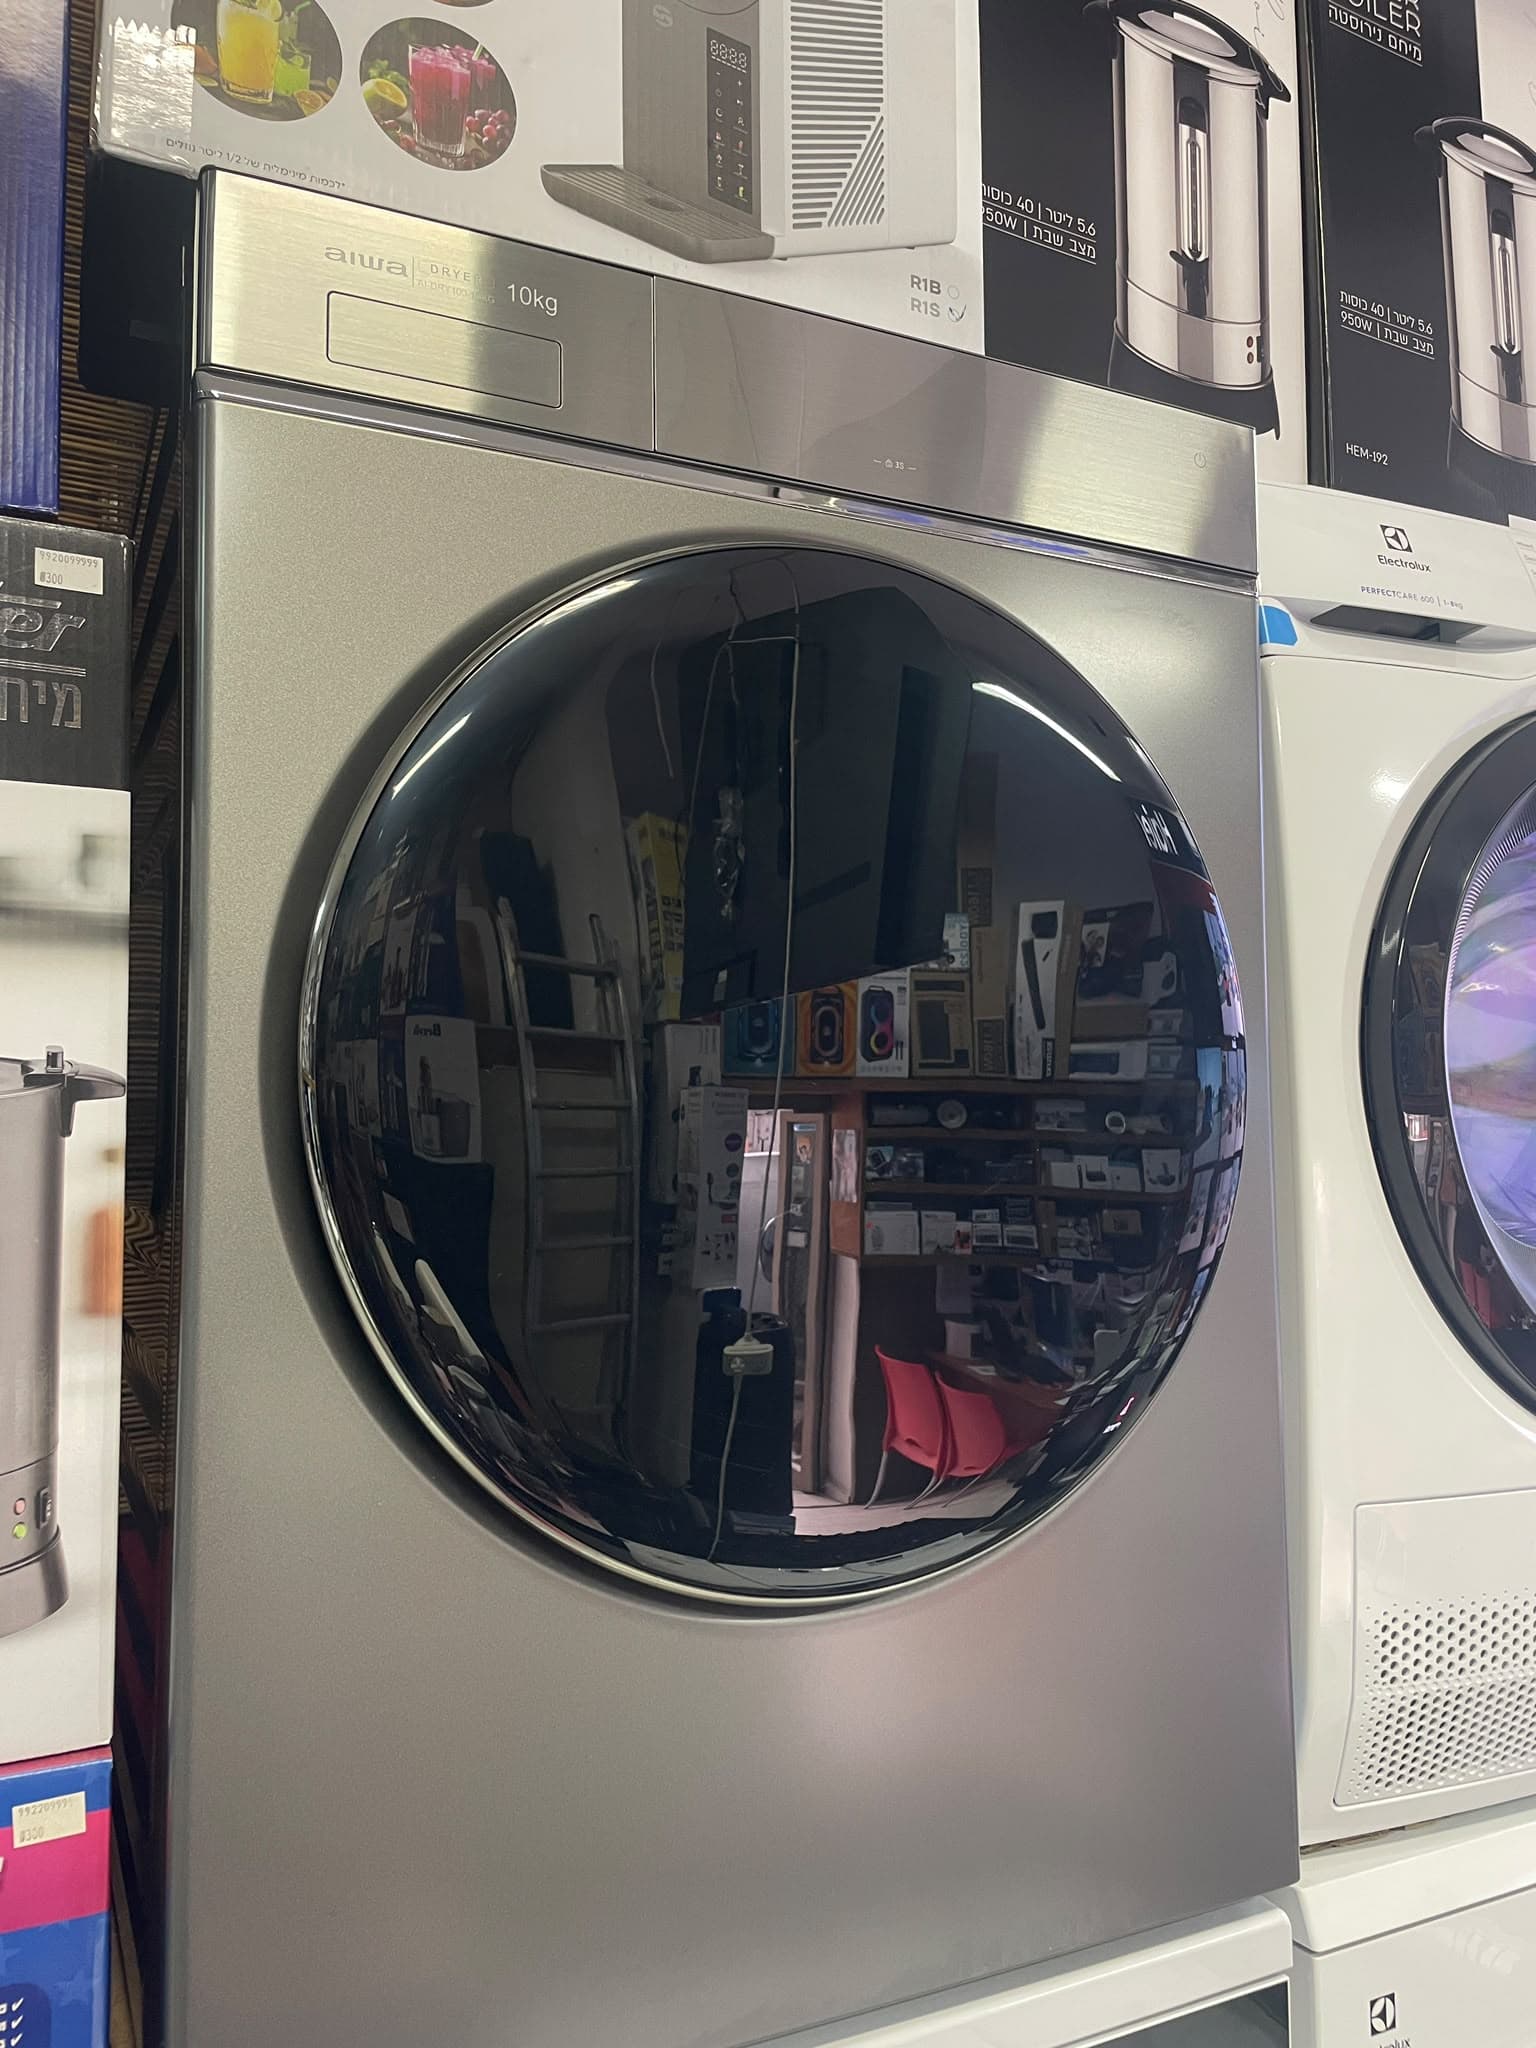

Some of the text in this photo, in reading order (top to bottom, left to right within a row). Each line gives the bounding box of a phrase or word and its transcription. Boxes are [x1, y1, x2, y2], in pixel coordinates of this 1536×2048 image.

[1328, 4, 1422, 61] מיחם נירוסטה
[226, 151, 241, 164] 1/2
[1016, 196, 1034, 214] 40
[1045, 206, 1073, 228] ליטר
[1077, 218, 1097, 237] 5.6
[981, 206, 1097, 259] מצב שבת 50W
[323, 246, 409, 278] aiwa
[910, 273, 942, 295] R1B
[506, 283, 558, 316] 10kg
[910, 297, 941, 318] R1S
[1340, 290, 1433, 335] 5.6 ליטר 40 כוסות
[1340, 310, 1434, 355] מצב שבת 950W
[1345, 442, 1389, 466] HEM-192
[1377, 554, 1432, 573] Electrolux
[1361, 586, 1418, 601] PERFECTCARE
